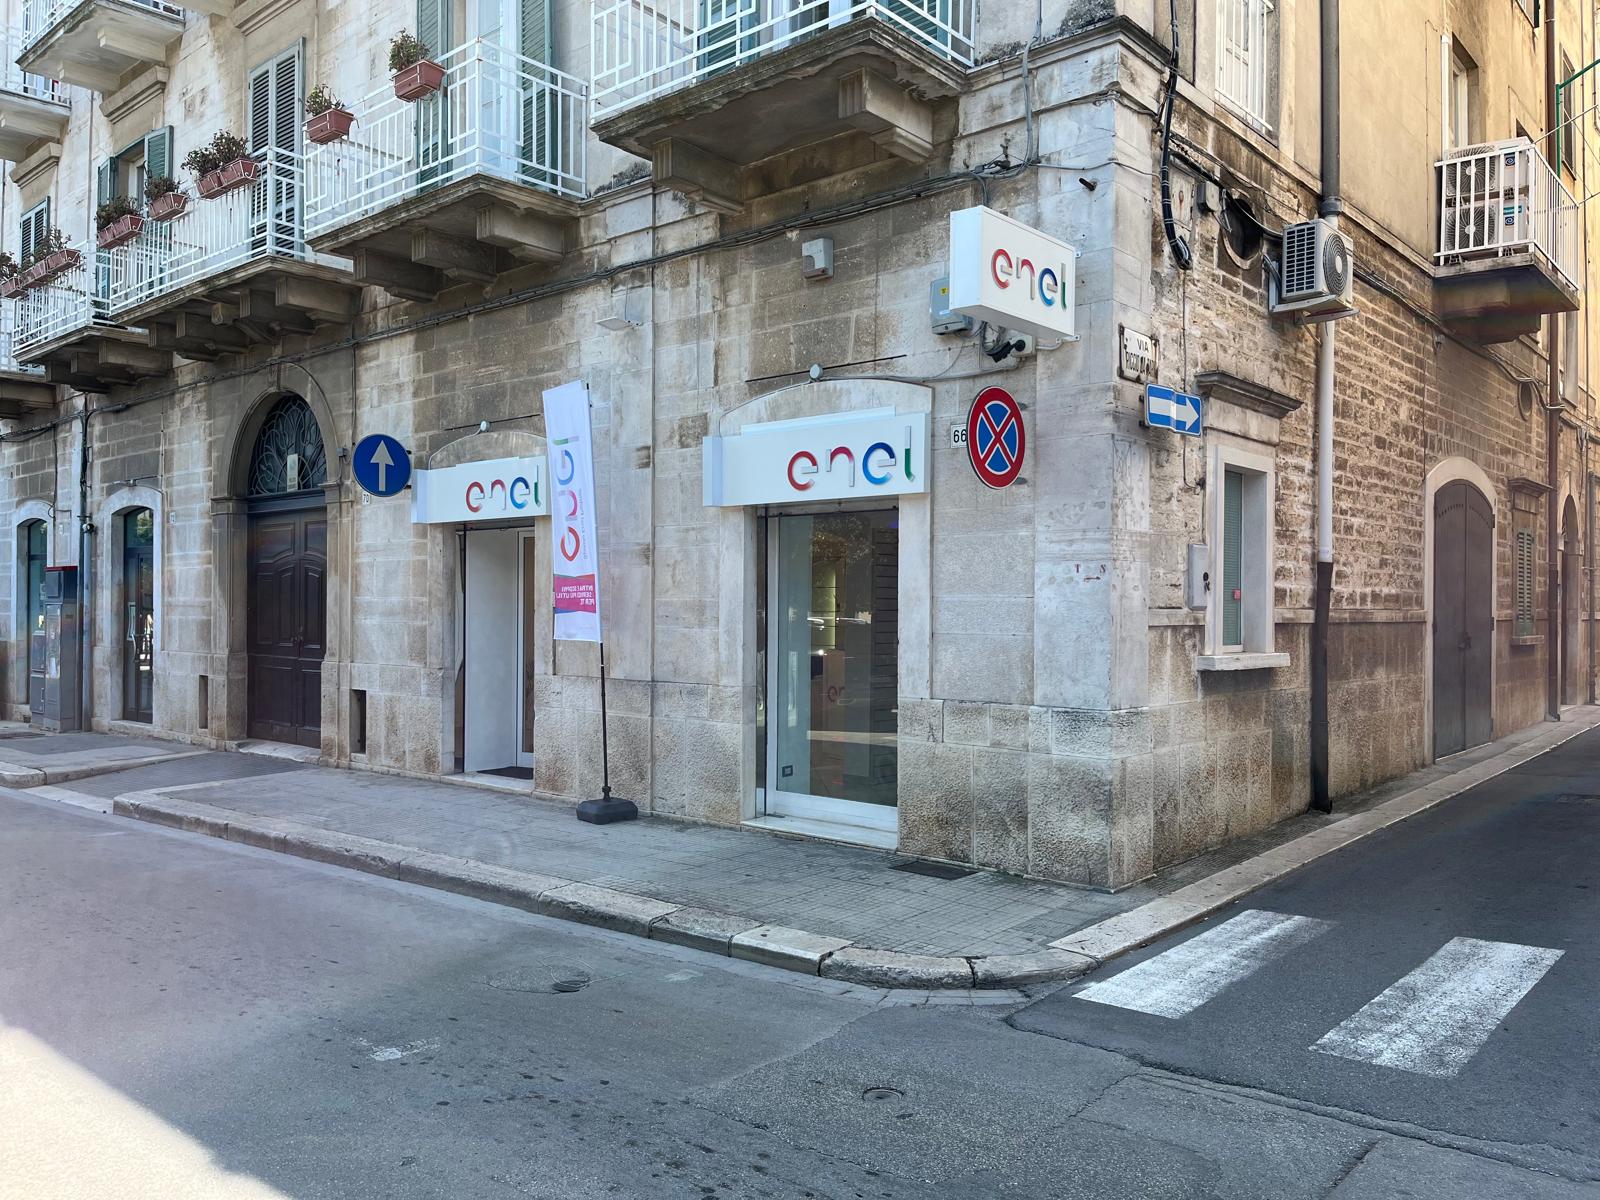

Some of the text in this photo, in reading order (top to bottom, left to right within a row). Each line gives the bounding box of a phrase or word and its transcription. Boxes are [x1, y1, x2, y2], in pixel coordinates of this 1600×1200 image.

[991, 248, 1067, 311] enel
[1137, 338, 1149, 352] VIA
[787, 425, 916, 491] enel
[953, 429, 967, 443] 66
[465, 464, 541, 513] enel
